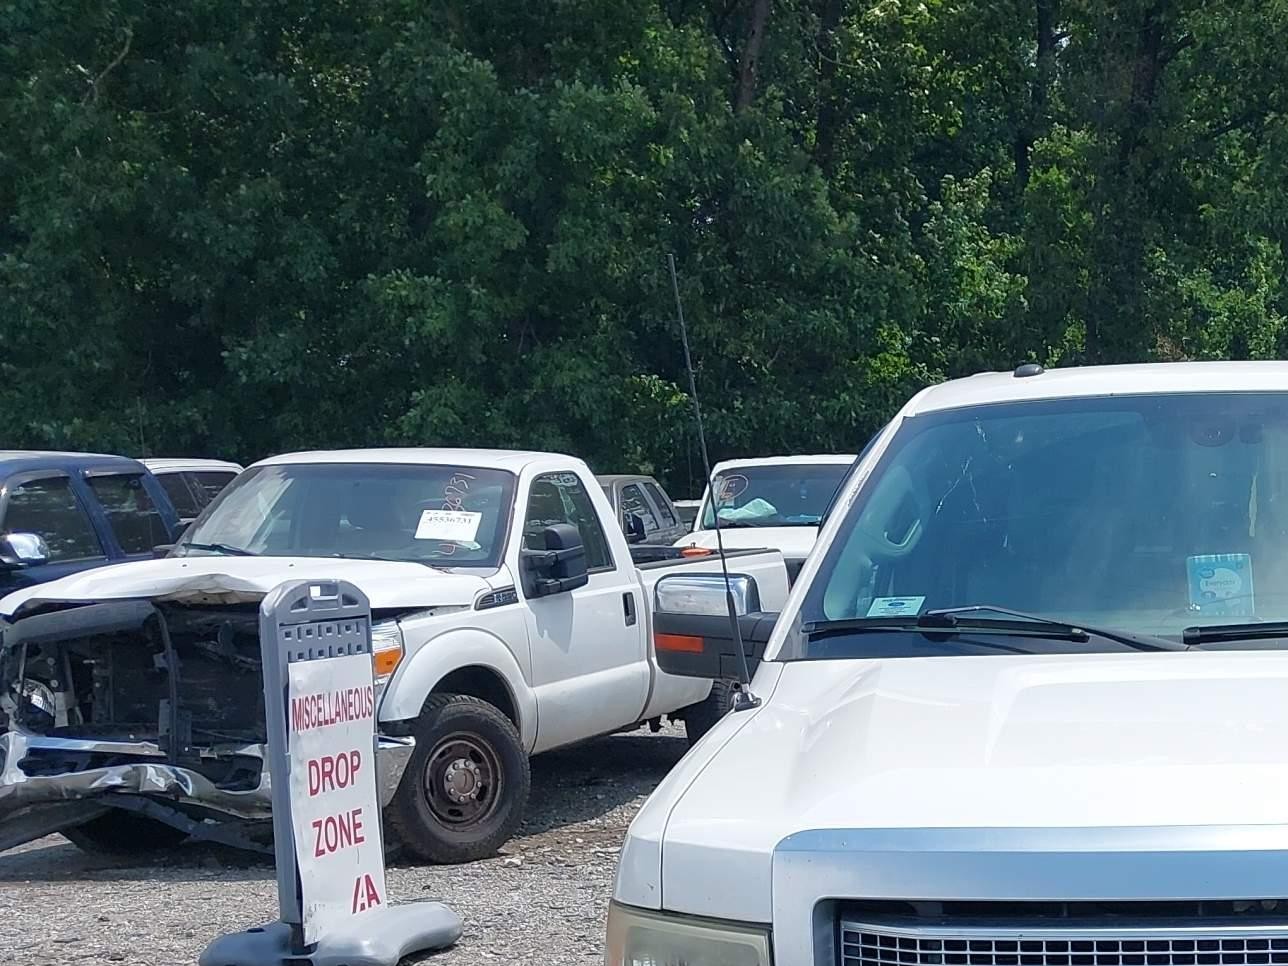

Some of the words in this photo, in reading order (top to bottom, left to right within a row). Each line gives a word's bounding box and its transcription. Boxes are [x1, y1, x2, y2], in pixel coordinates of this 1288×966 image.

[292, 686, 373, 732] MISCELLANEOUS
[308, 750, 361, 796] DROP
[312, 808, 365, 857] ZONE
